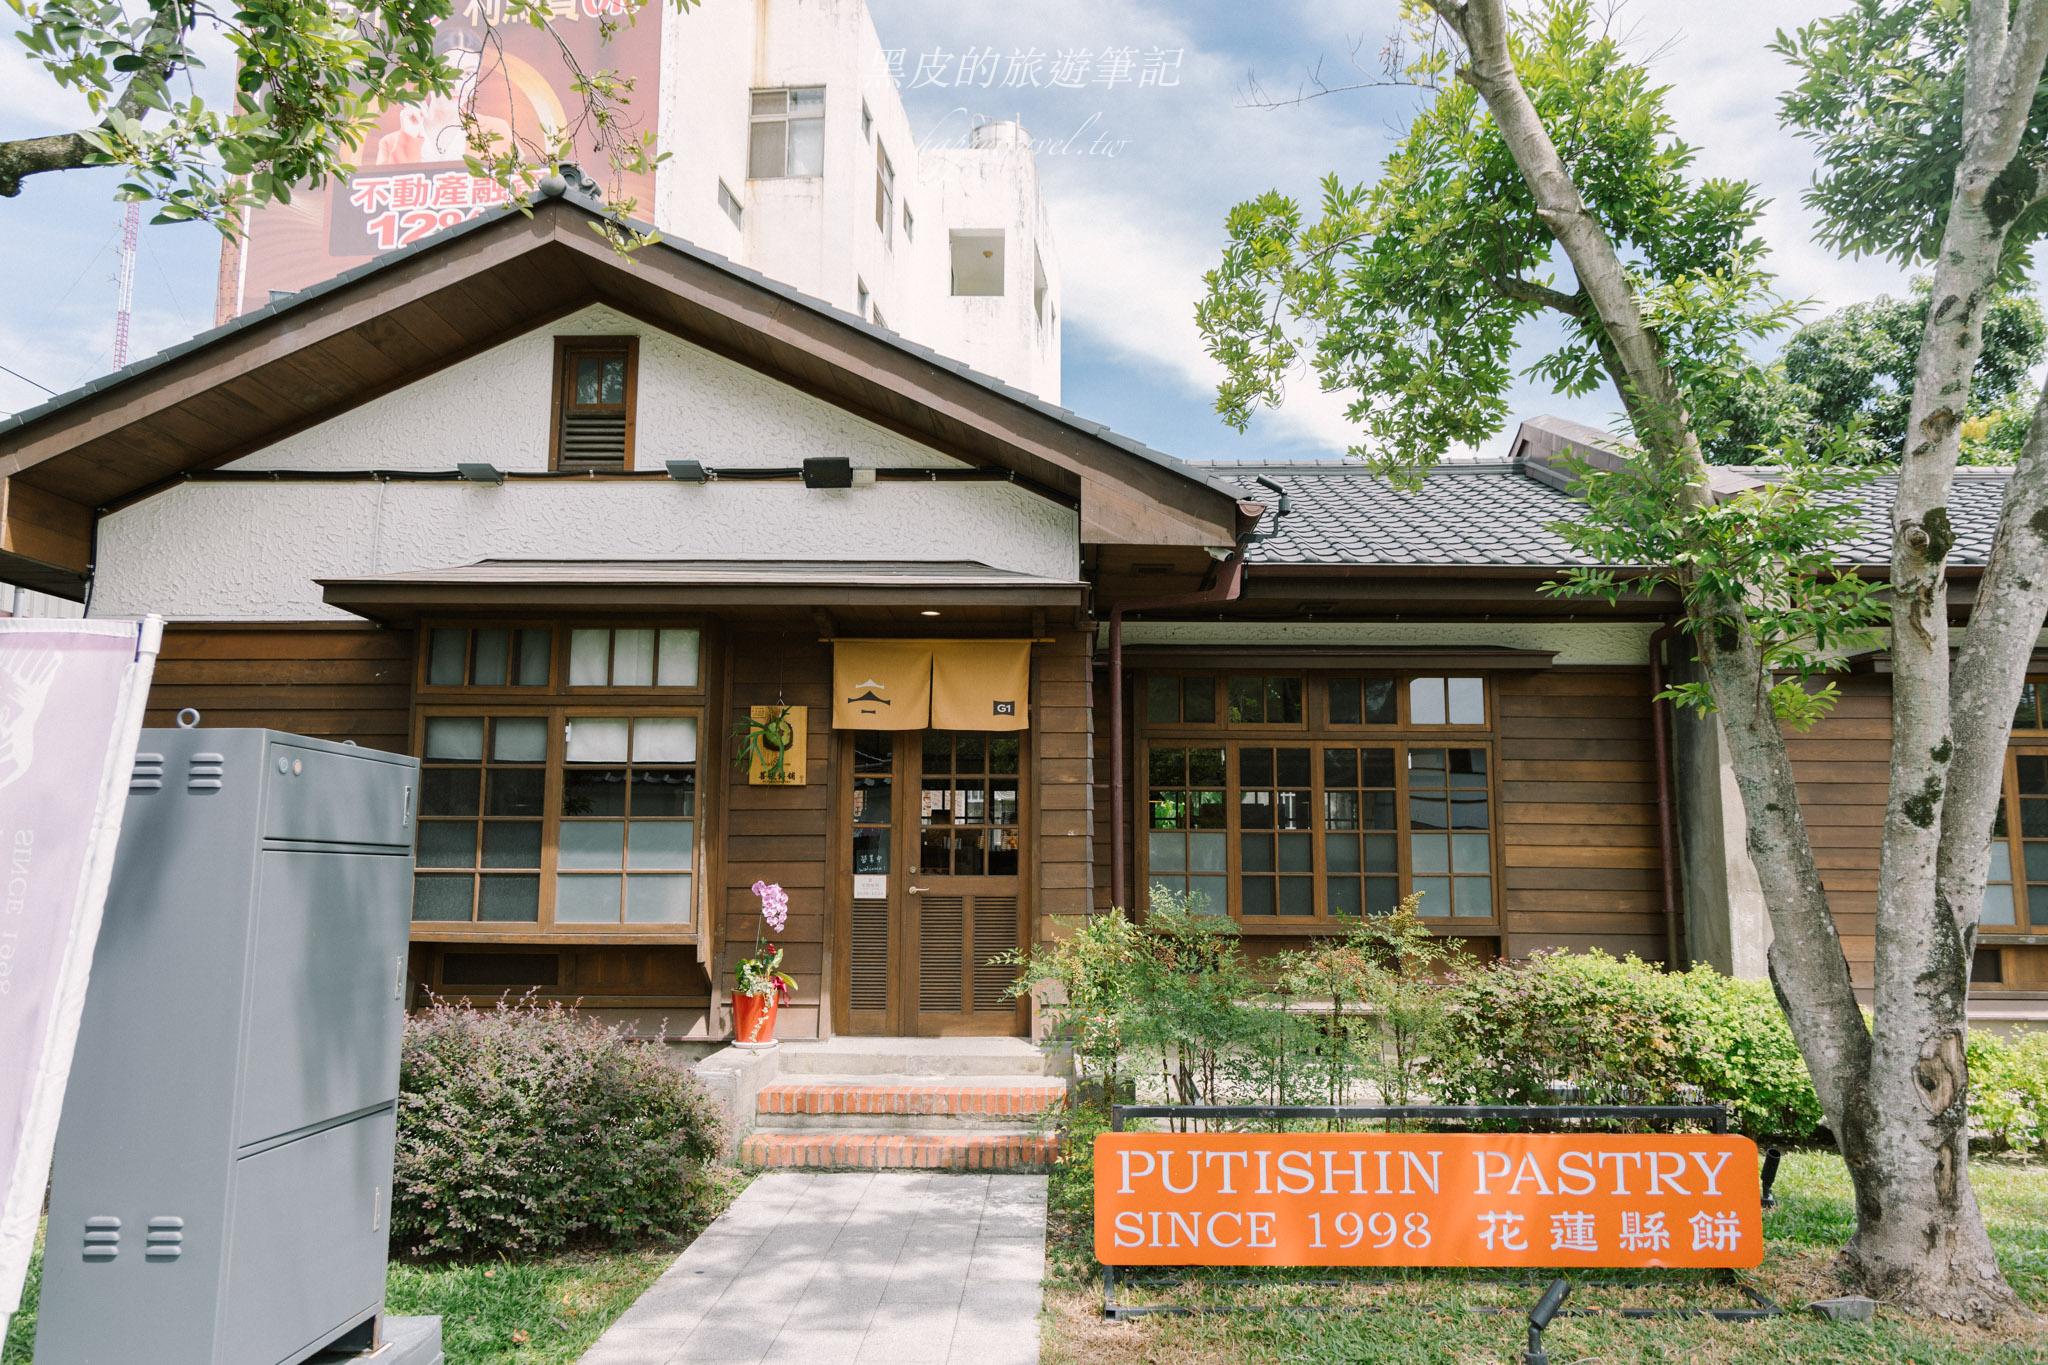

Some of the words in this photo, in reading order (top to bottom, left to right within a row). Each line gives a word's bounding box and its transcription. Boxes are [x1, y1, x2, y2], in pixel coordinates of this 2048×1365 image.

[996, 704, 1011, 713] G1
[1116, 1150, 1443, 1194] PUTISHIN
[1472, 1151, 1733, 1196] PASTRY
[1114, 1211, 1277, 1248] SINCE
[1307, 1211, 1432, 1249] 1998
[1476, 1210, 1742, 1251] 花蓮縣餅
